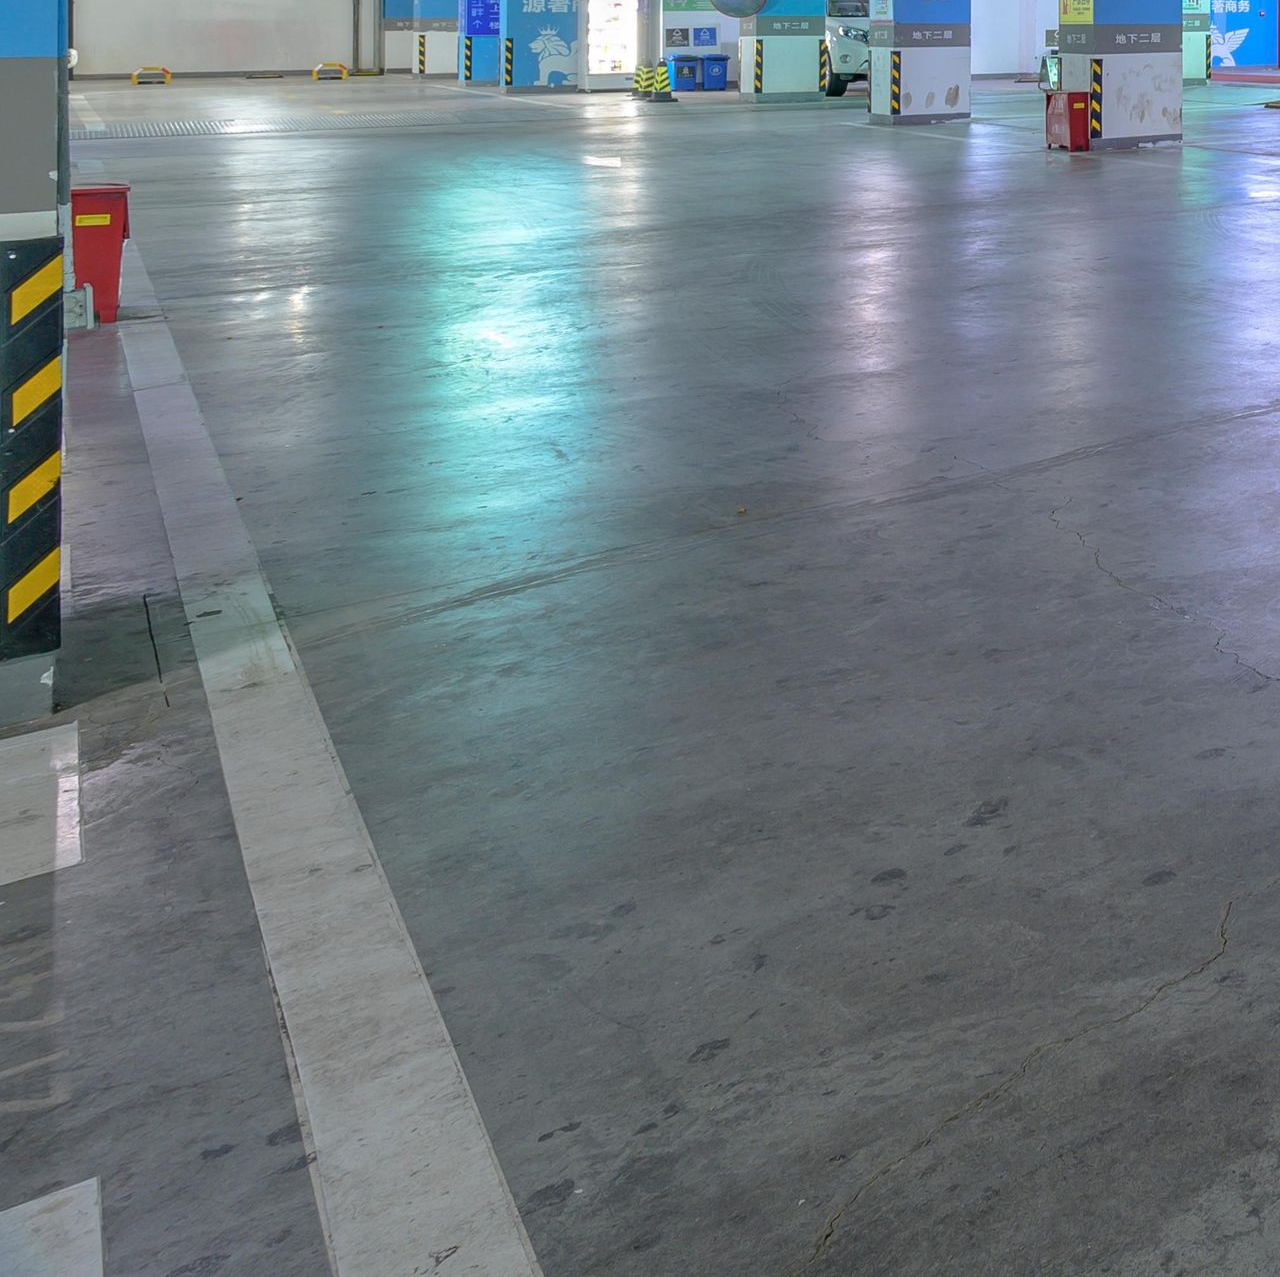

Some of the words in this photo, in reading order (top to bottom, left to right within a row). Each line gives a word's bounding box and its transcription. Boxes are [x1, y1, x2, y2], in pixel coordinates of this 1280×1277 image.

[912, 30, 953, 39] 地下二层
[1115, 32, 1161, 44] 地下二层
